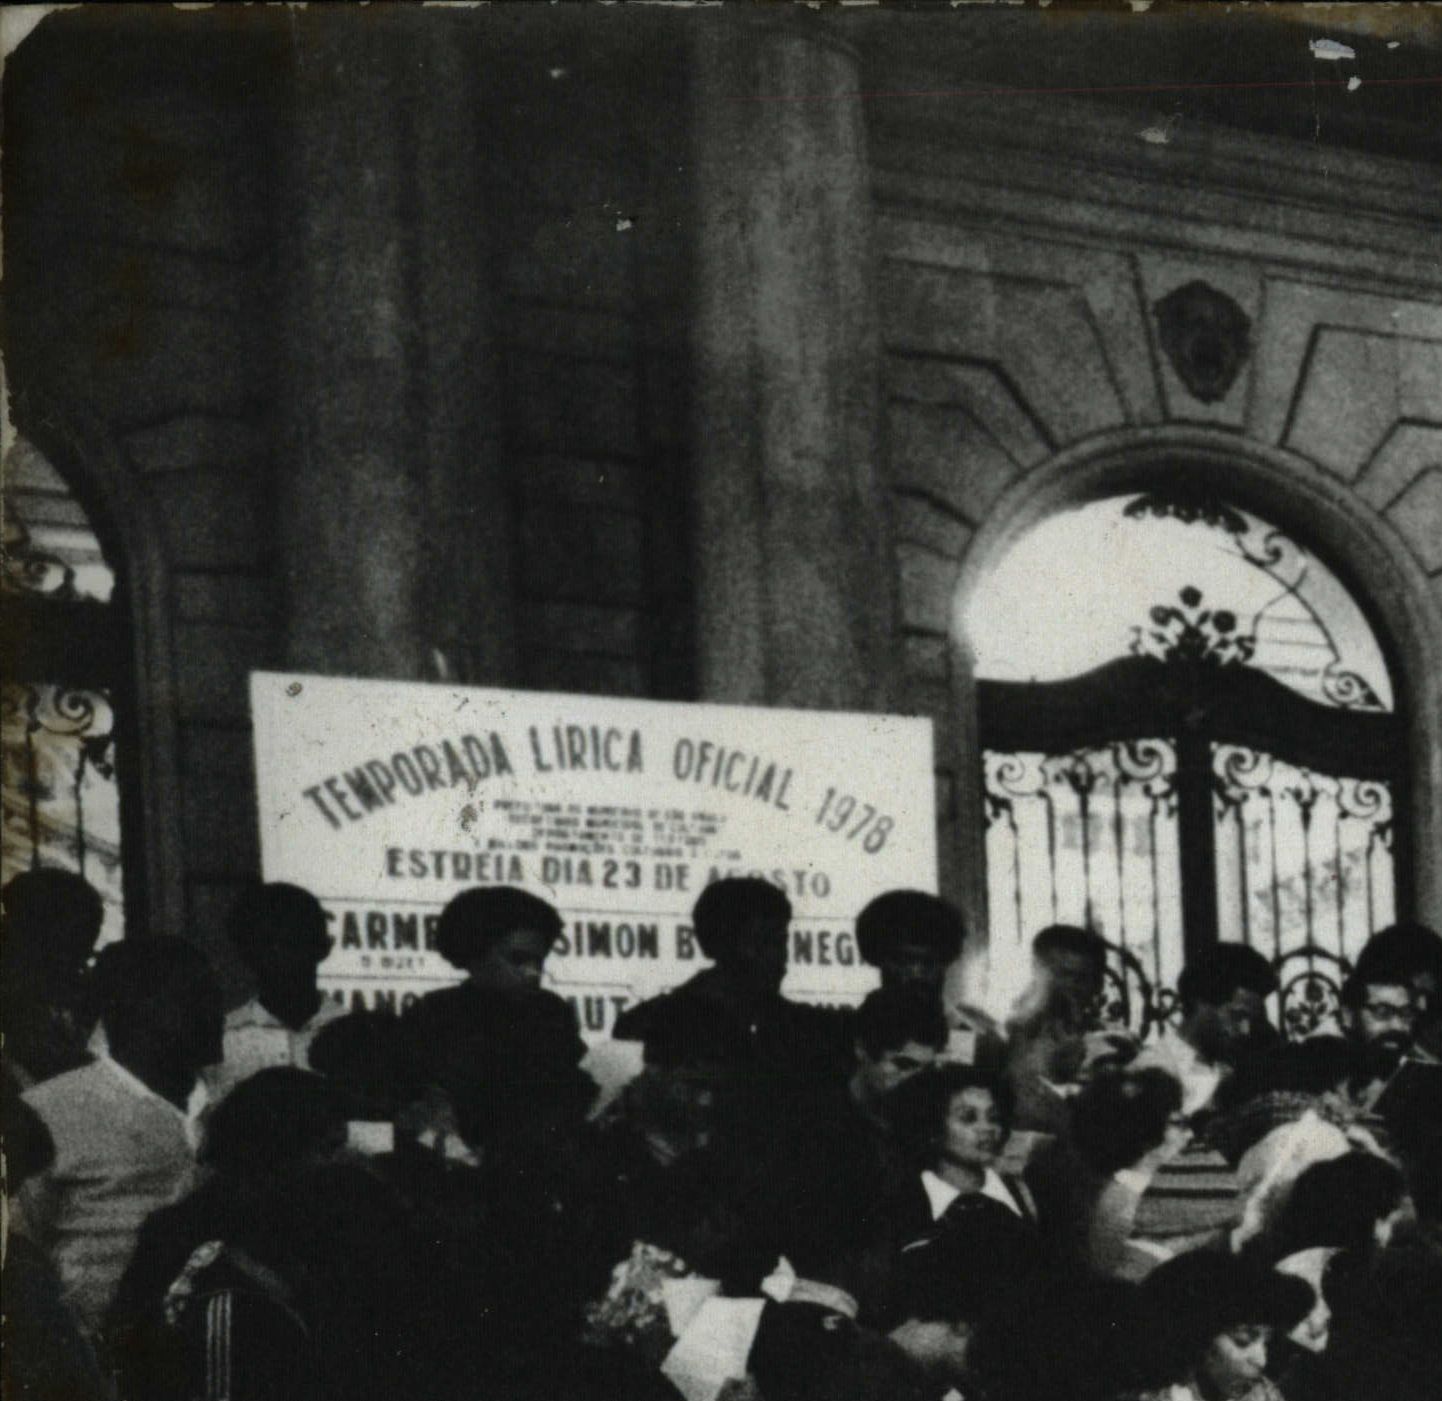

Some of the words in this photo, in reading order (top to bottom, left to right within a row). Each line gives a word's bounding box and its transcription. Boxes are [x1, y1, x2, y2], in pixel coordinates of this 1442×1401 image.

[303, 731, 513, 831] TEMPORADA
[673, 737, 793, 811] OFICIAL
[814, 786, 895, 854] 1978
[386, 847, 524, 882] ESTREIA
[541, 856, 593, 885] DIA
[602, 858, 642, 889] 23
[654, 863, 690, 892] DE
